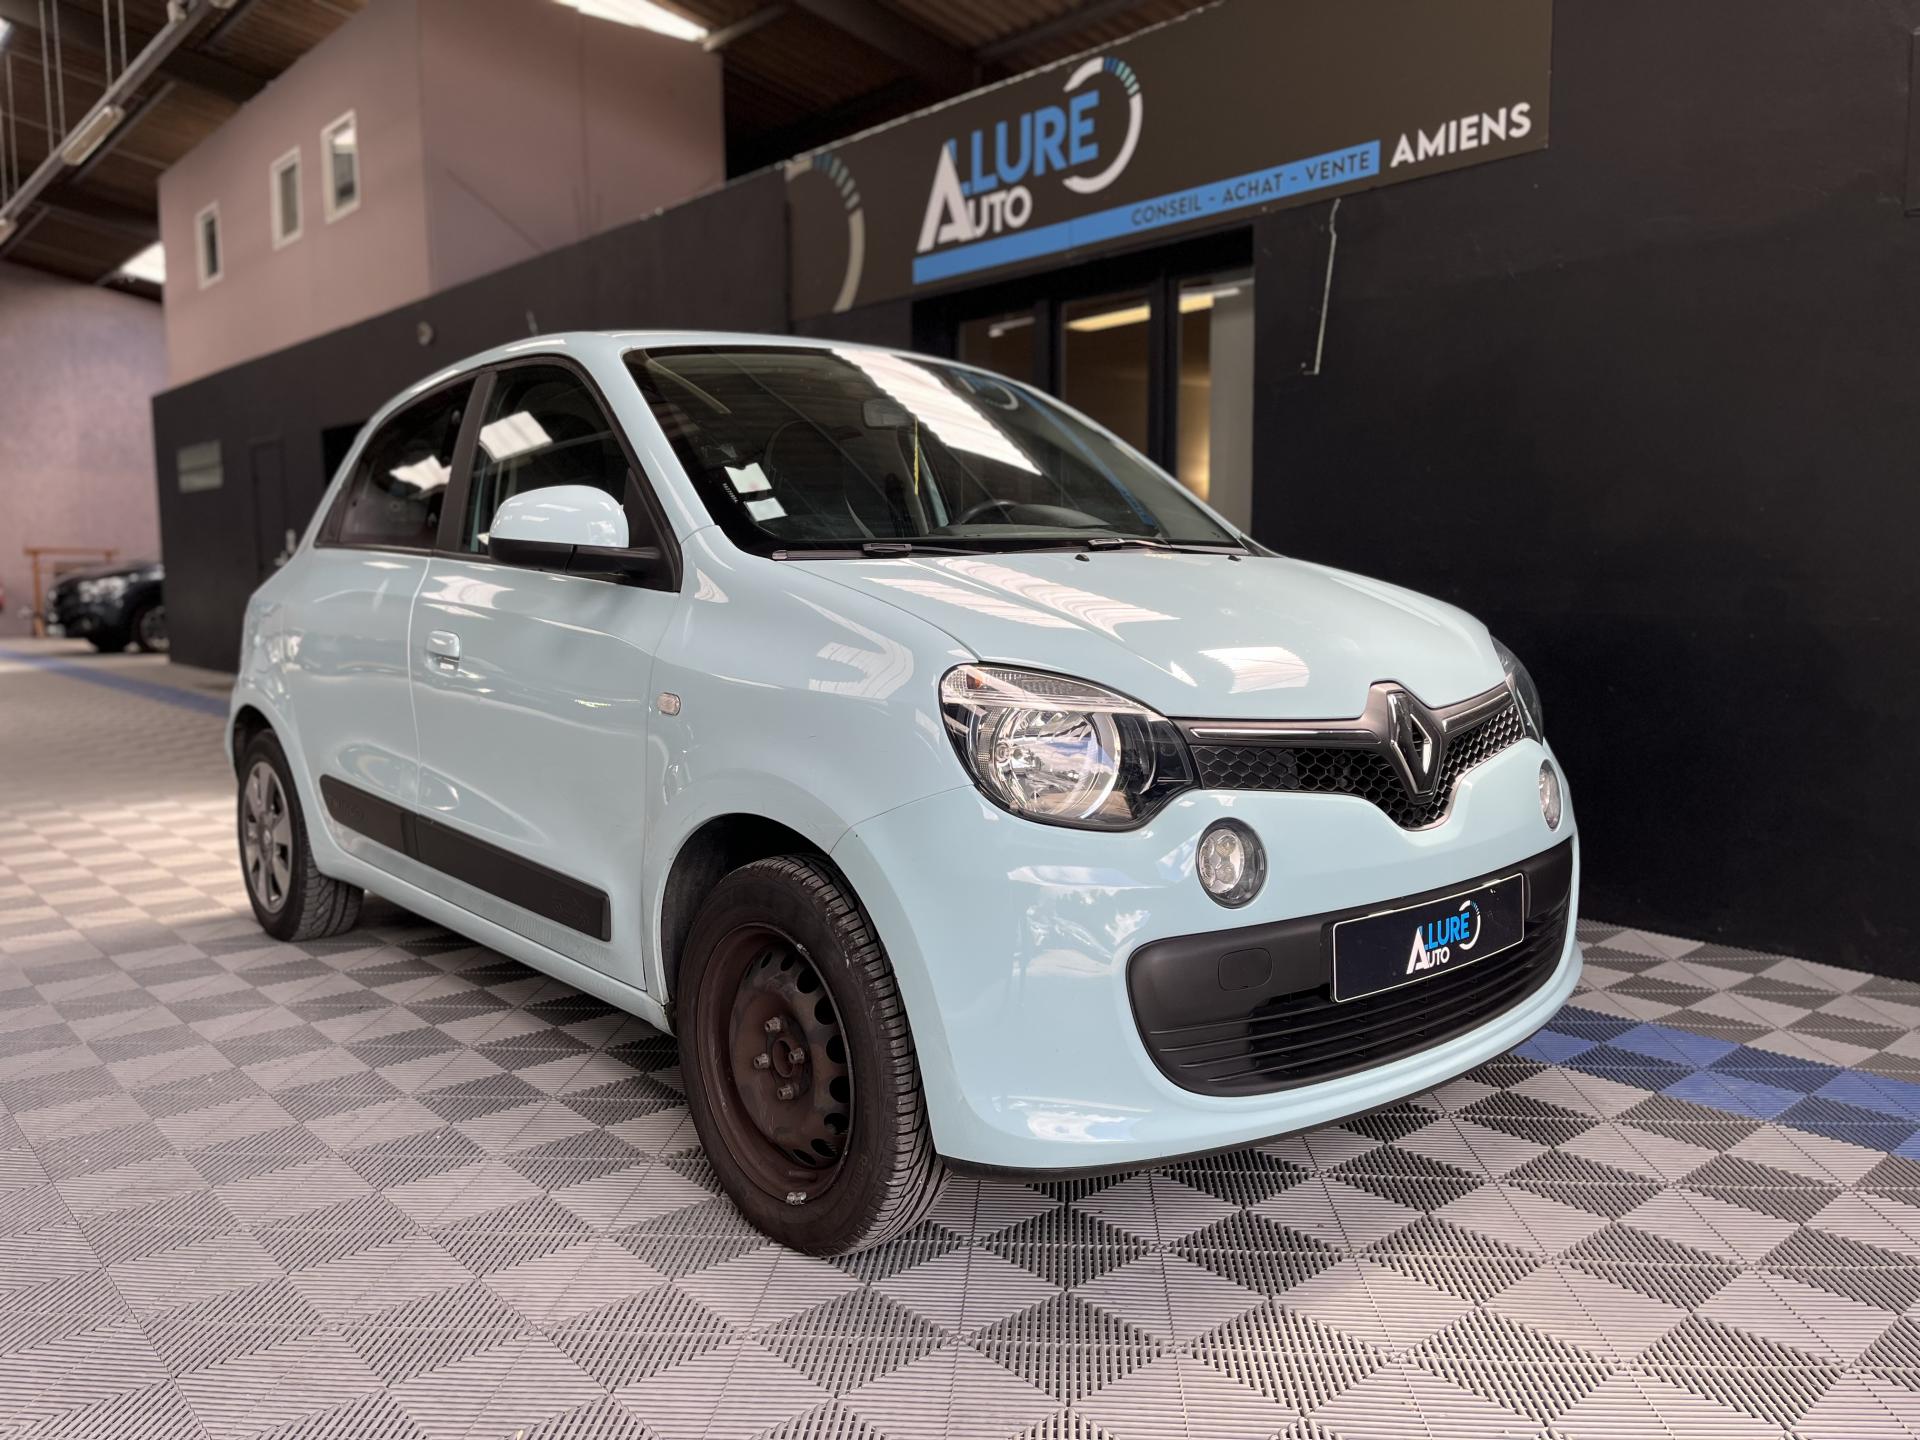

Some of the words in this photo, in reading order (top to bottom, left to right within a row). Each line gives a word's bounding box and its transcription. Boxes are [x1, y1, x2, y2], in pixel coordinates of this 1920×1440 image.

[1389, 102, 1532, 168] AMIENS
[916, 142, 1033, 253] AUTO
[1130, 193, 1203, 226] CONSEIL
[1222, 173, 1282, 206] ACHAT
[1305, 150, 1370, 183] VENTE
[1406, 927, 1450, 974] AUTO
